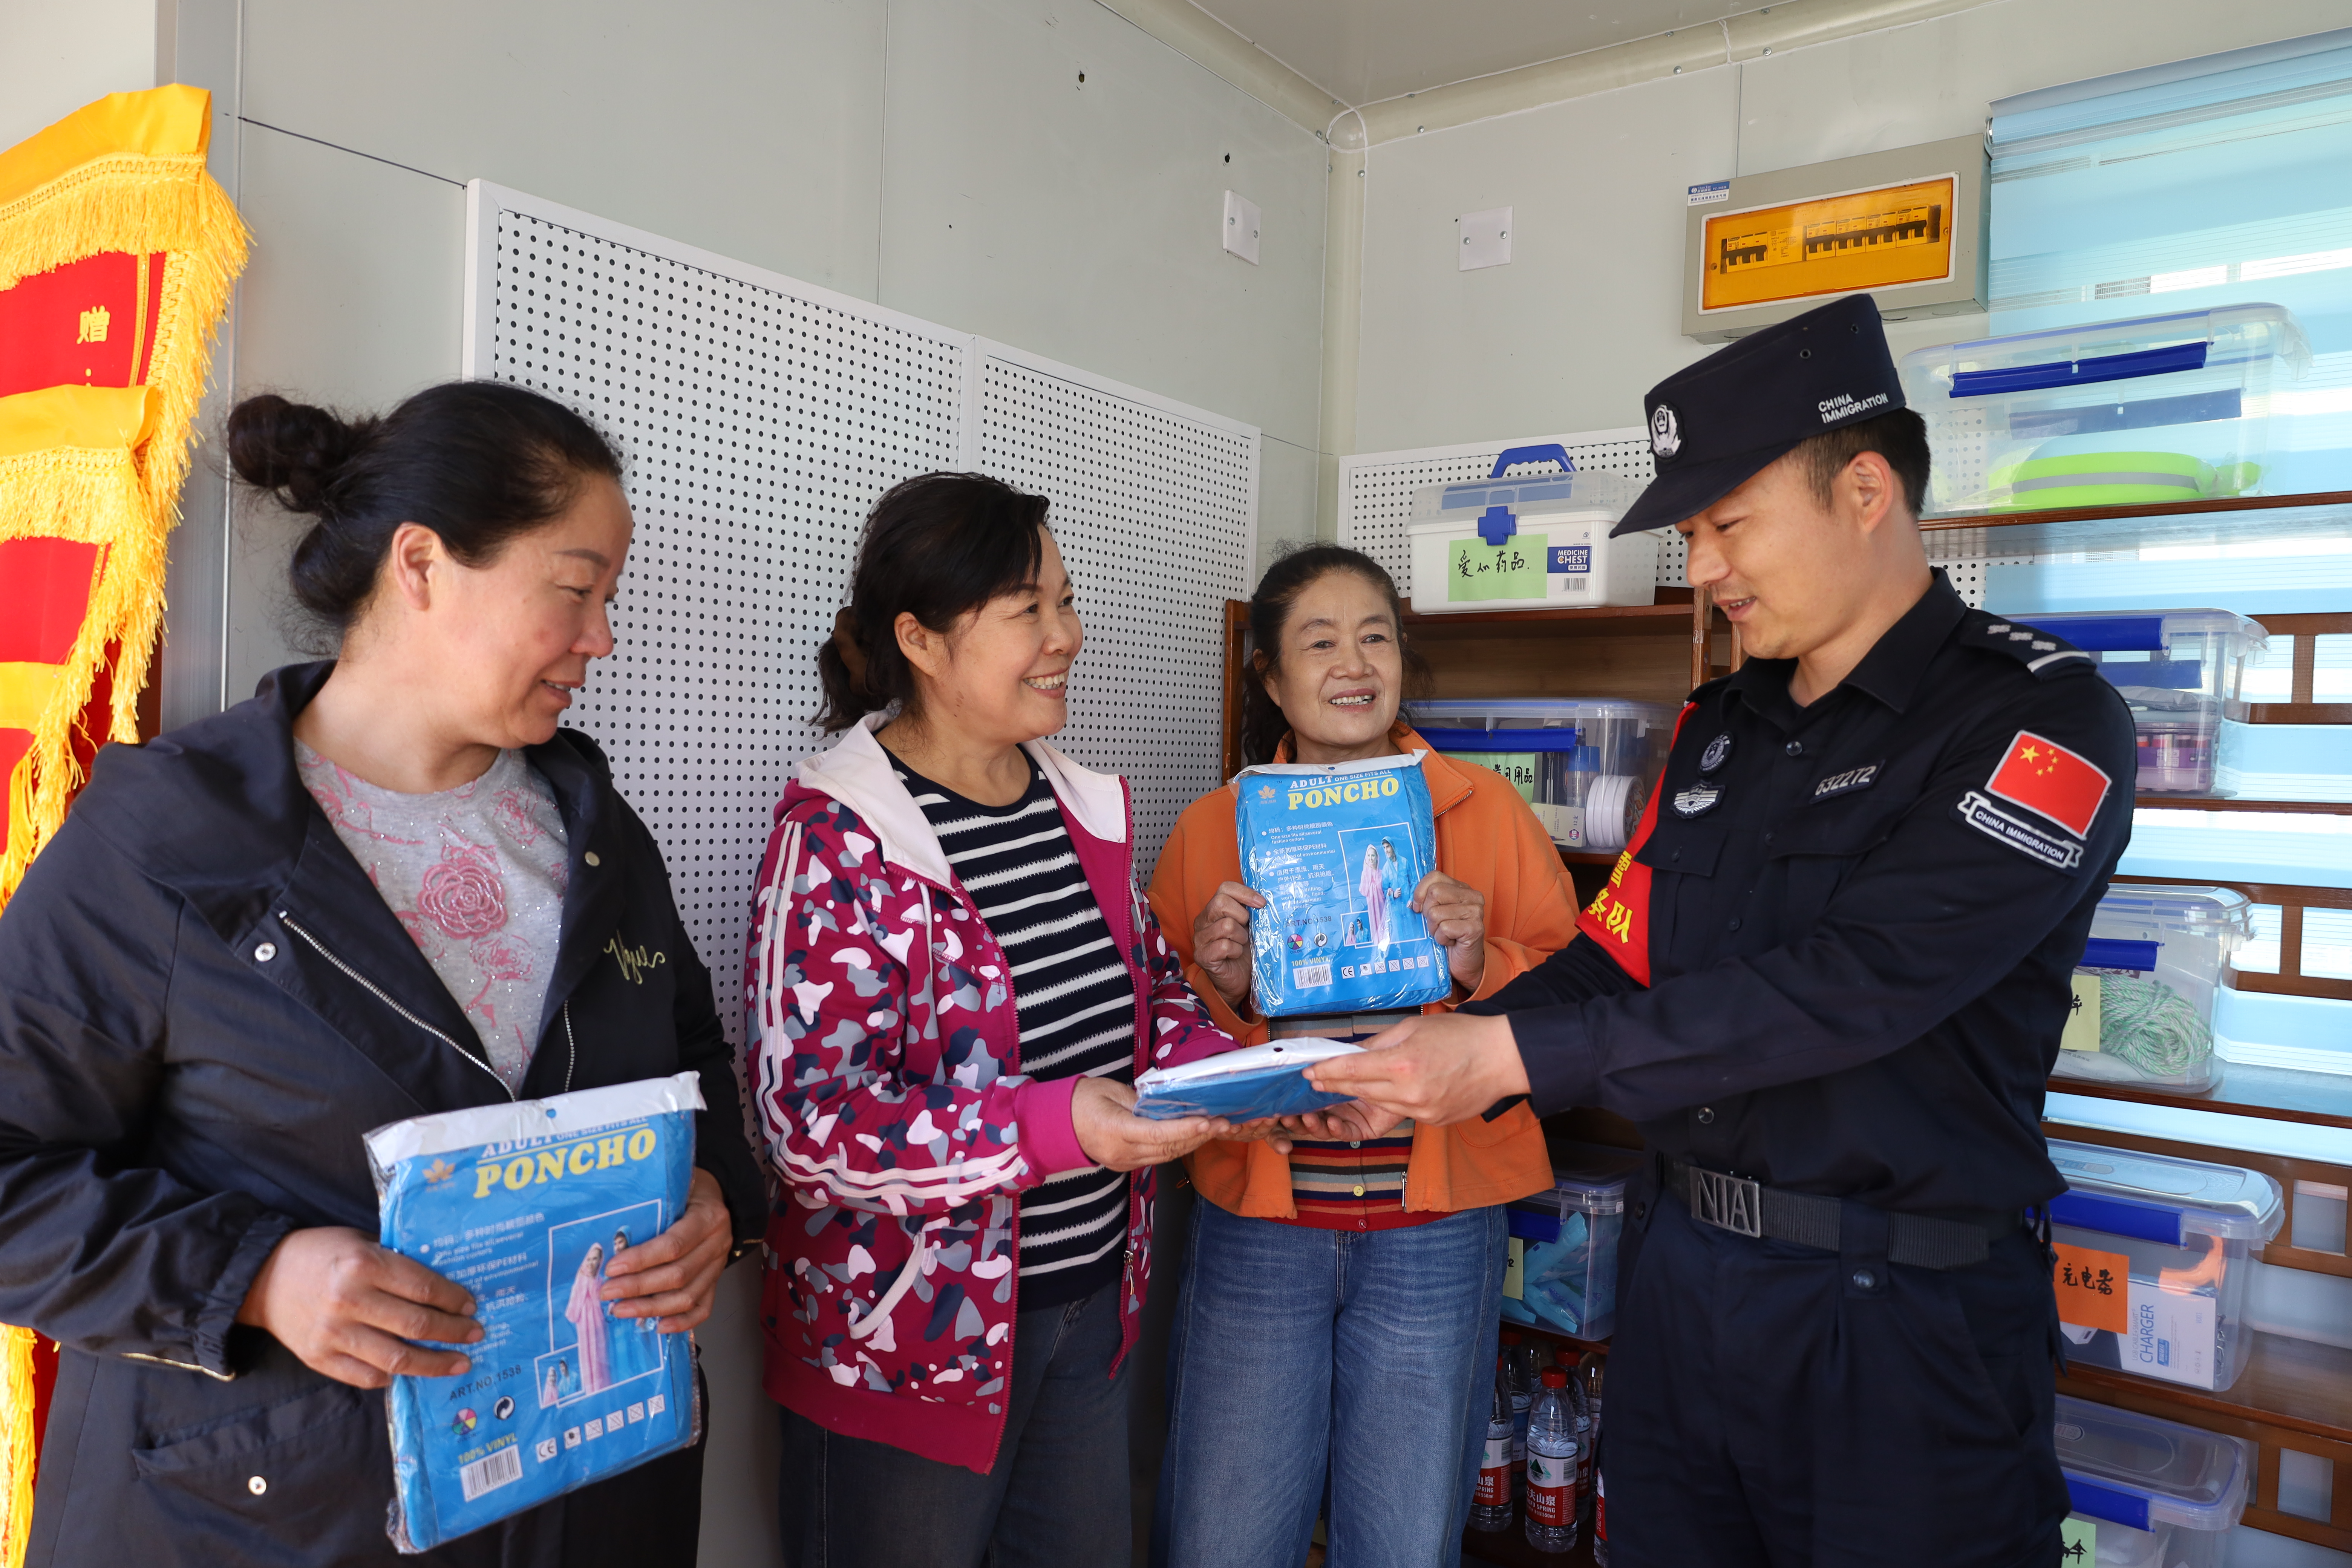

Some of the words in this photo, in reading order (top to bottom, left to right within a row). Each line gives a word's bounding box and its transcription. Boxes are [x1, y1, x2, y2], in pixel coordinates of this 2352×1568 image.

[1818, 393, 1853, 412] CHINA
[1821, 393, 1889, 424] IMMIGRATION
[1557, 556, 1588, 564] CHEST
[1288, 777, 1399, 810] PONCHO
[1290, 775, 1333, 789] ADULT
[1815, 766, 1877, 796] 632272
[1571, 829, 1577, 839] HB
[1975, 811, 2005, 831] CHINA
[2005, 826, 2065, 861] IMMIGRATION
[1286, 916, 1332, 928] ART.NO1538
[1309, 956, 1330, 964] VINYL
[481, 1134, 553, 1158] ADULT
[473, 1129, 657, 1199] PONCHO
[2063, 1263, 2113, 1295] 充电器
[2139, 1304, 2154, 1363] CHARGER
[450, 1364, 522, 1401] ART.NO.1538
[458, 1447, 485, 1464] 100%
[486, 1433, 518, 1452] VINYL
[1537, 1504, 1556, 1513] SPRING
